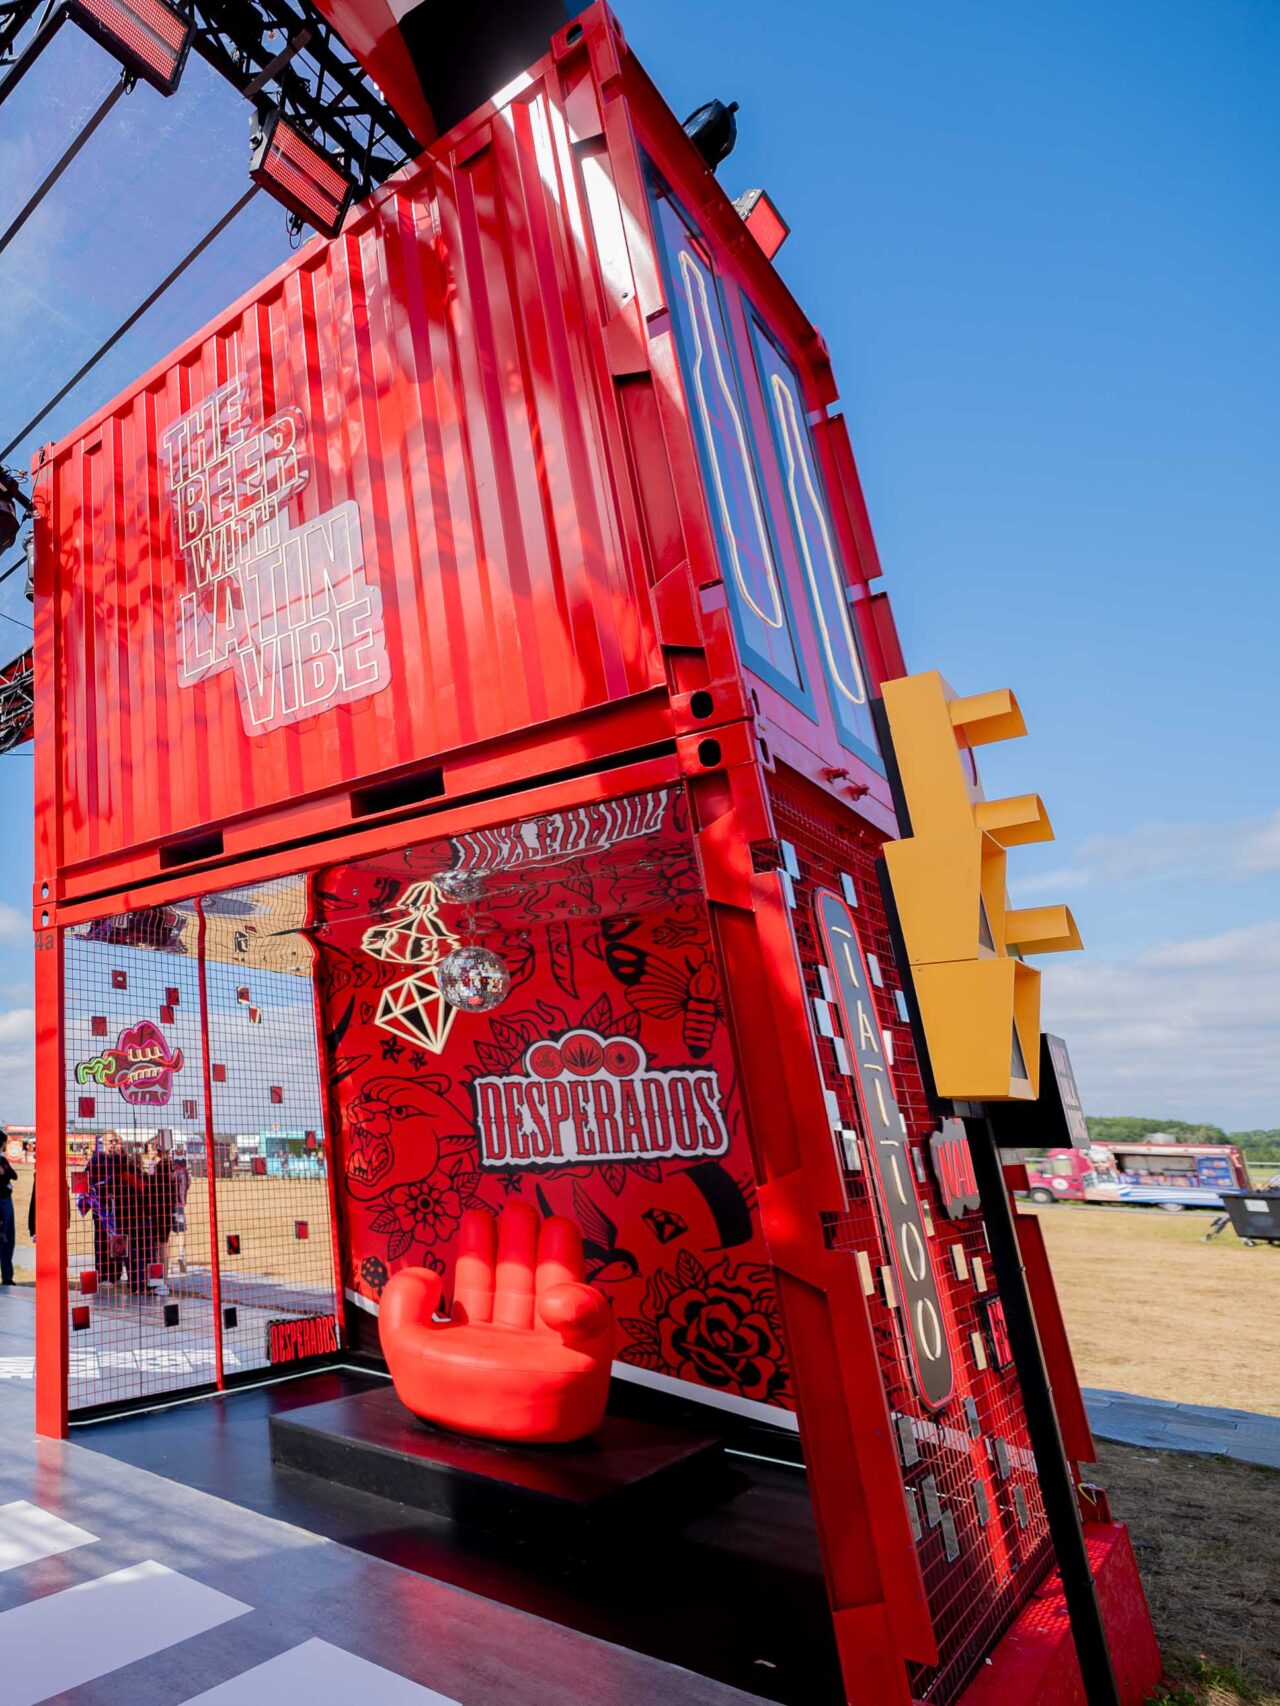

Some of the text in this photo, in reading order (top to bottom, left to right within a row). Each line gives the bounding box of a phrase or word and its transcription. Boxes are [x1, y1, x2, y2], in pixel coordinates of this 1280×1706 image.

[163, 385, 245, 489] THE
[177, 416, 299, 549] BEER
[191, 495, 281, 588] WITH
[181, 513, 356, 677] LATIN
[239, 597, 379, 726] VIBE
[477, 1075, 721, 1160] DESPERADOS
[271, 1315, 337, 1364] DESPERADOS
